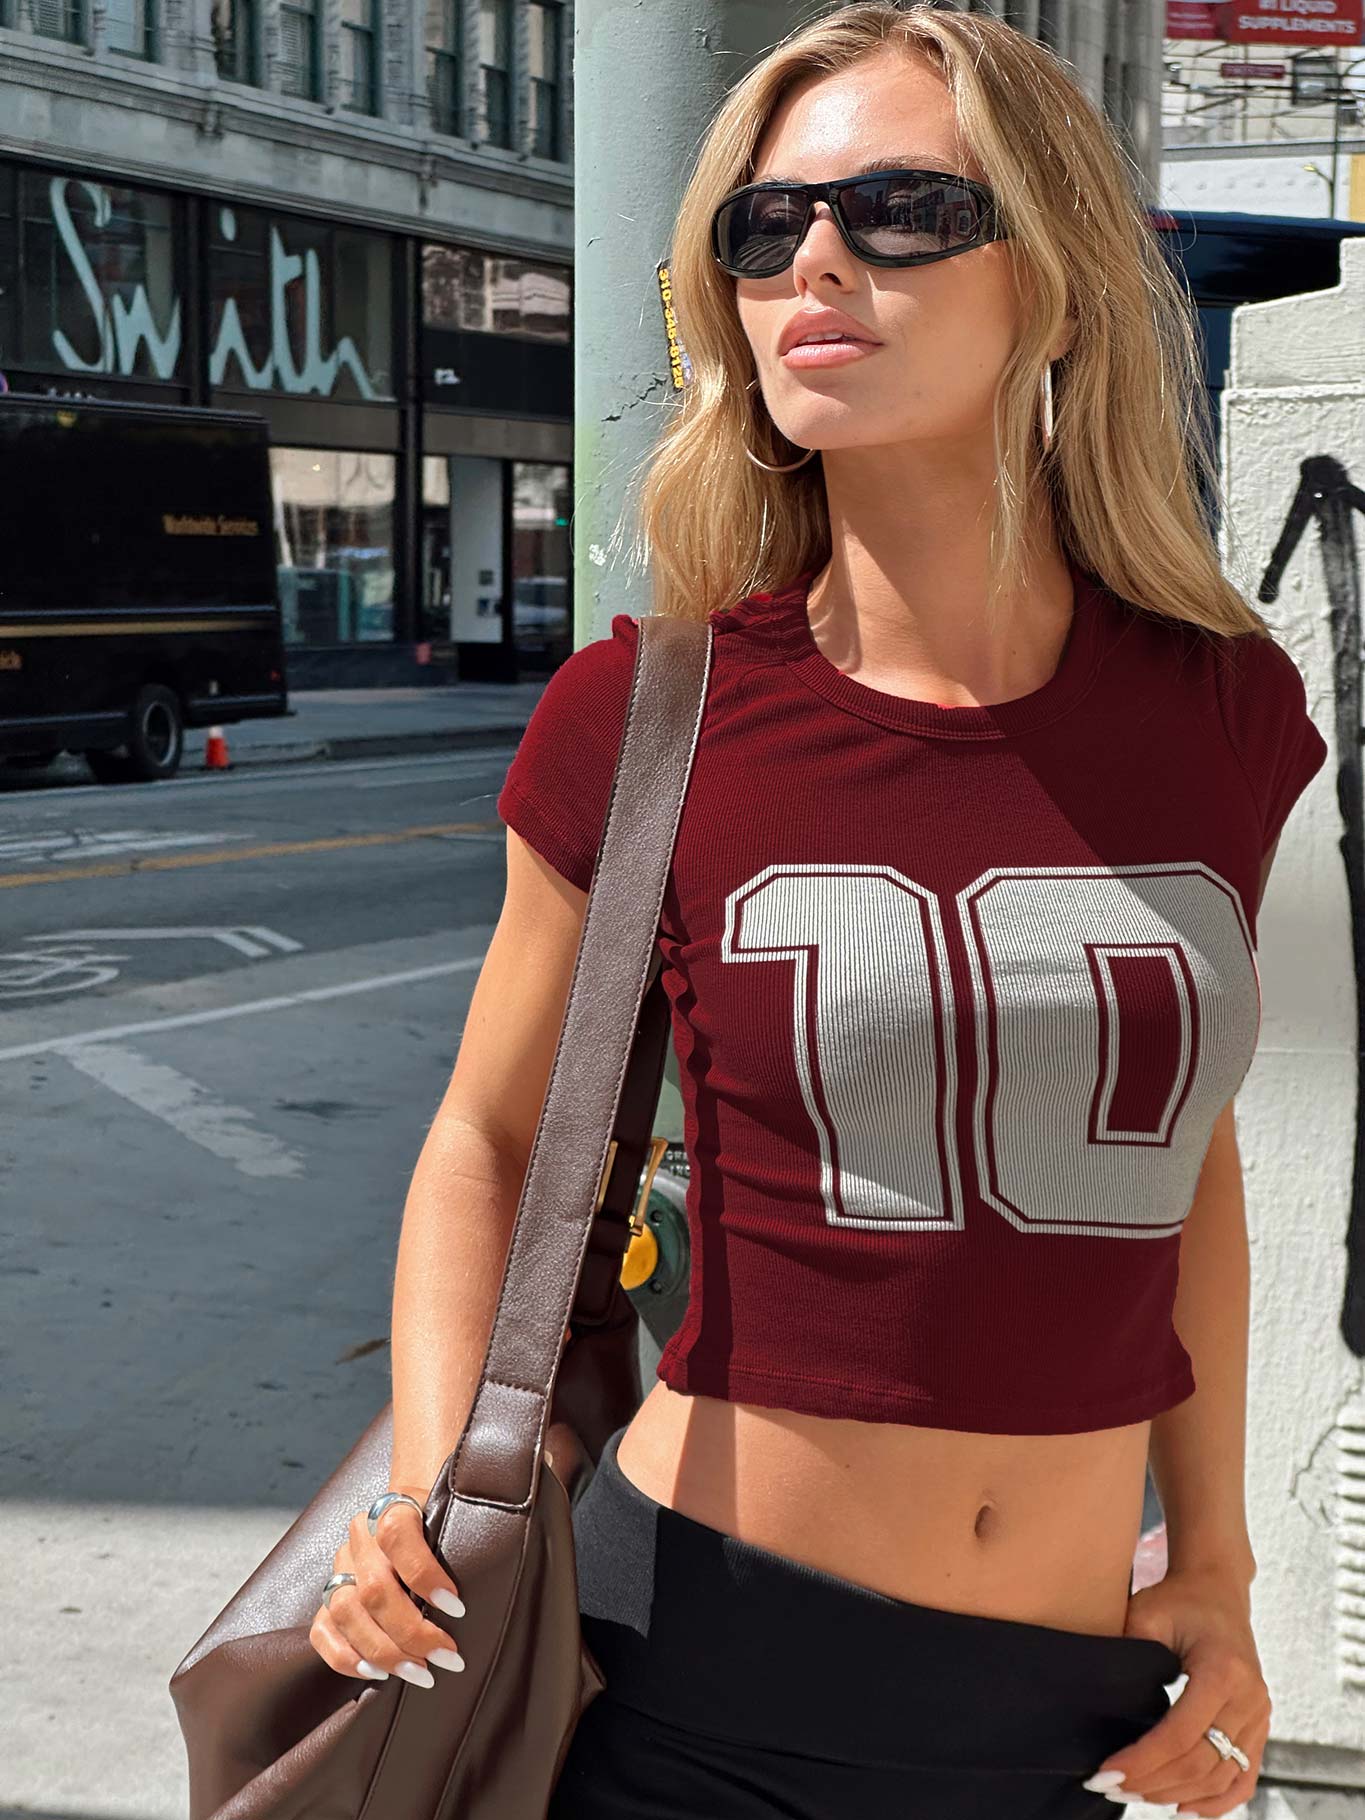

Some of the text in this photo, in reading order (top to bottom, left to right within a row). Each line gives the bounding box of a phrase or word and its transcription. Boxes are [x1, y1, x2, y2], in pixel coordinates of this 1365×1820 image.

[1239, 16, 1357, 34] SUPPLEMENTS
[51, 176, 397, 402] Smith
[722, 862, 1261, 1240] 10
